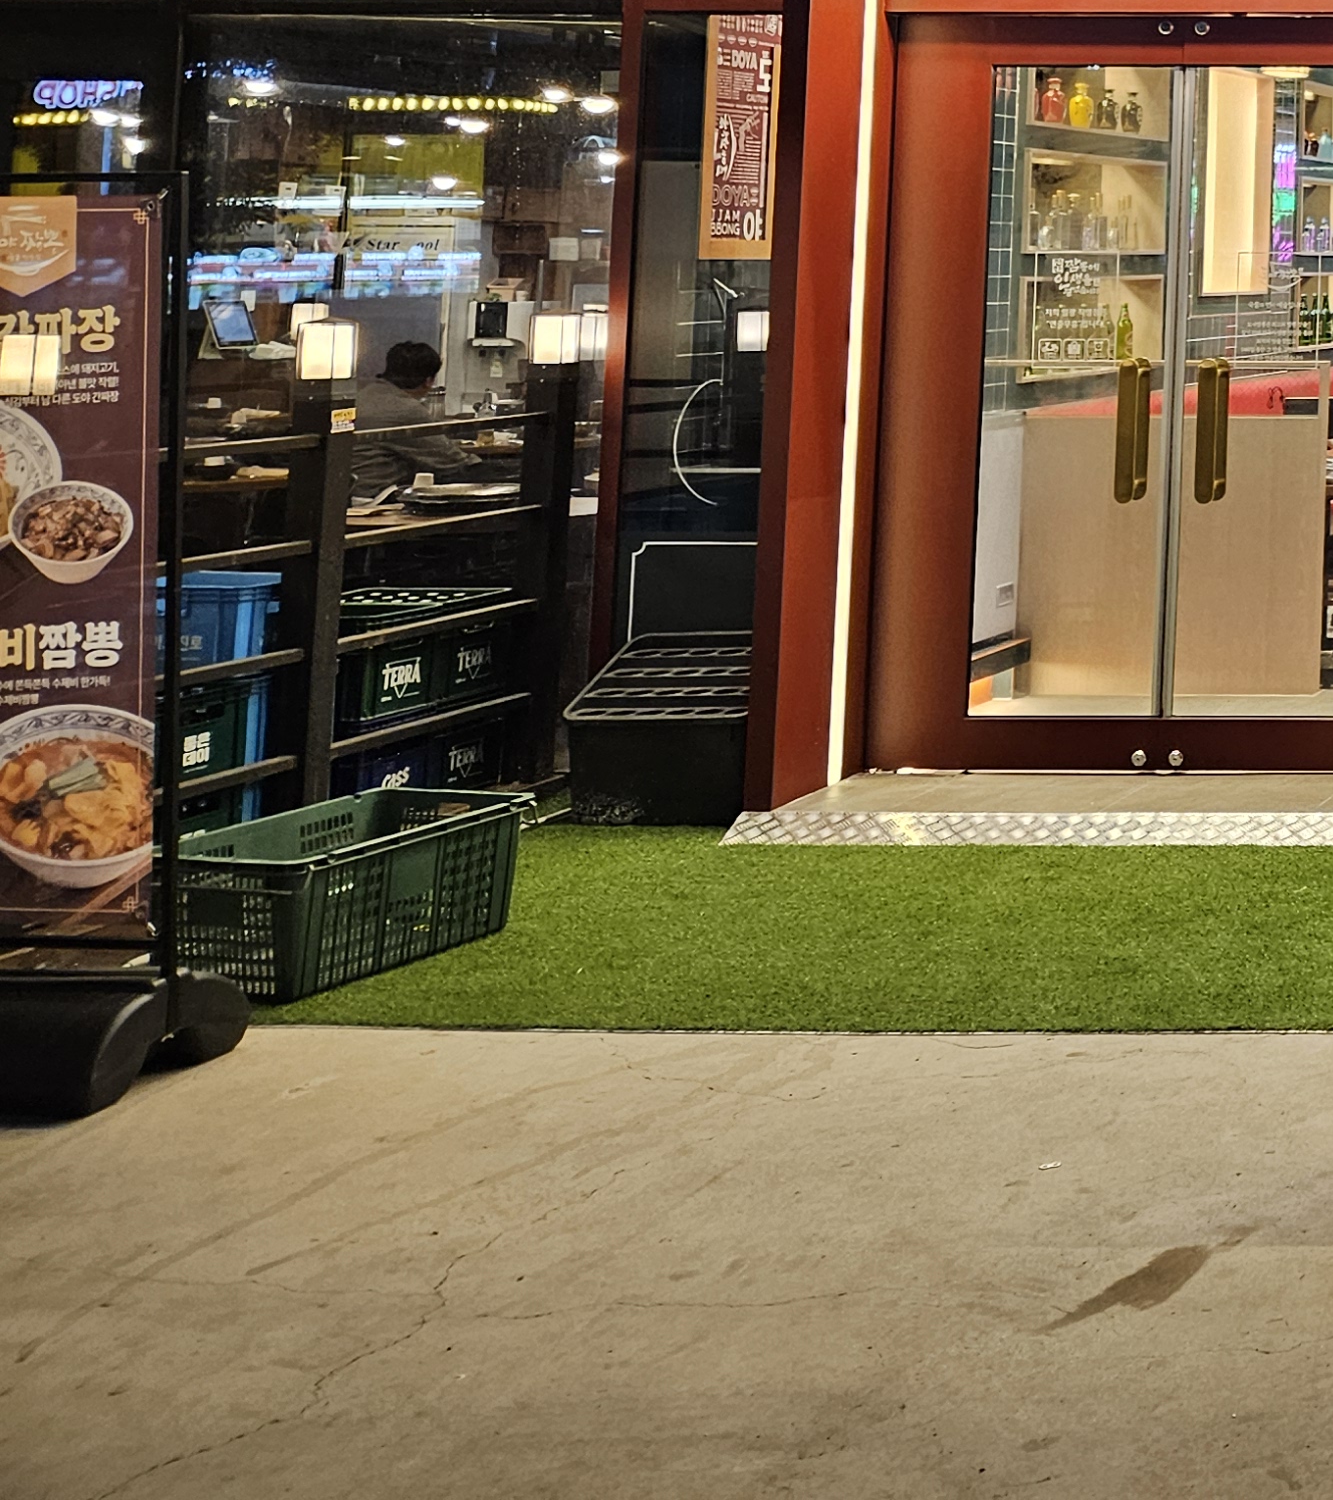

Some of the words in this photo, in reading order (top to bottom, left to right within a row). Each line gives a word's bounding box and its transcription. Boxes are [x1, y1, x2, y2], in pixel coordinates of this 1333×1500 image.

[731, 49, 758, 70] DOYA
[457, 648, 492, 673] TERRA
[381, 661, 422, 691] TERRA
[448, 746, 484, 772] TERRA
